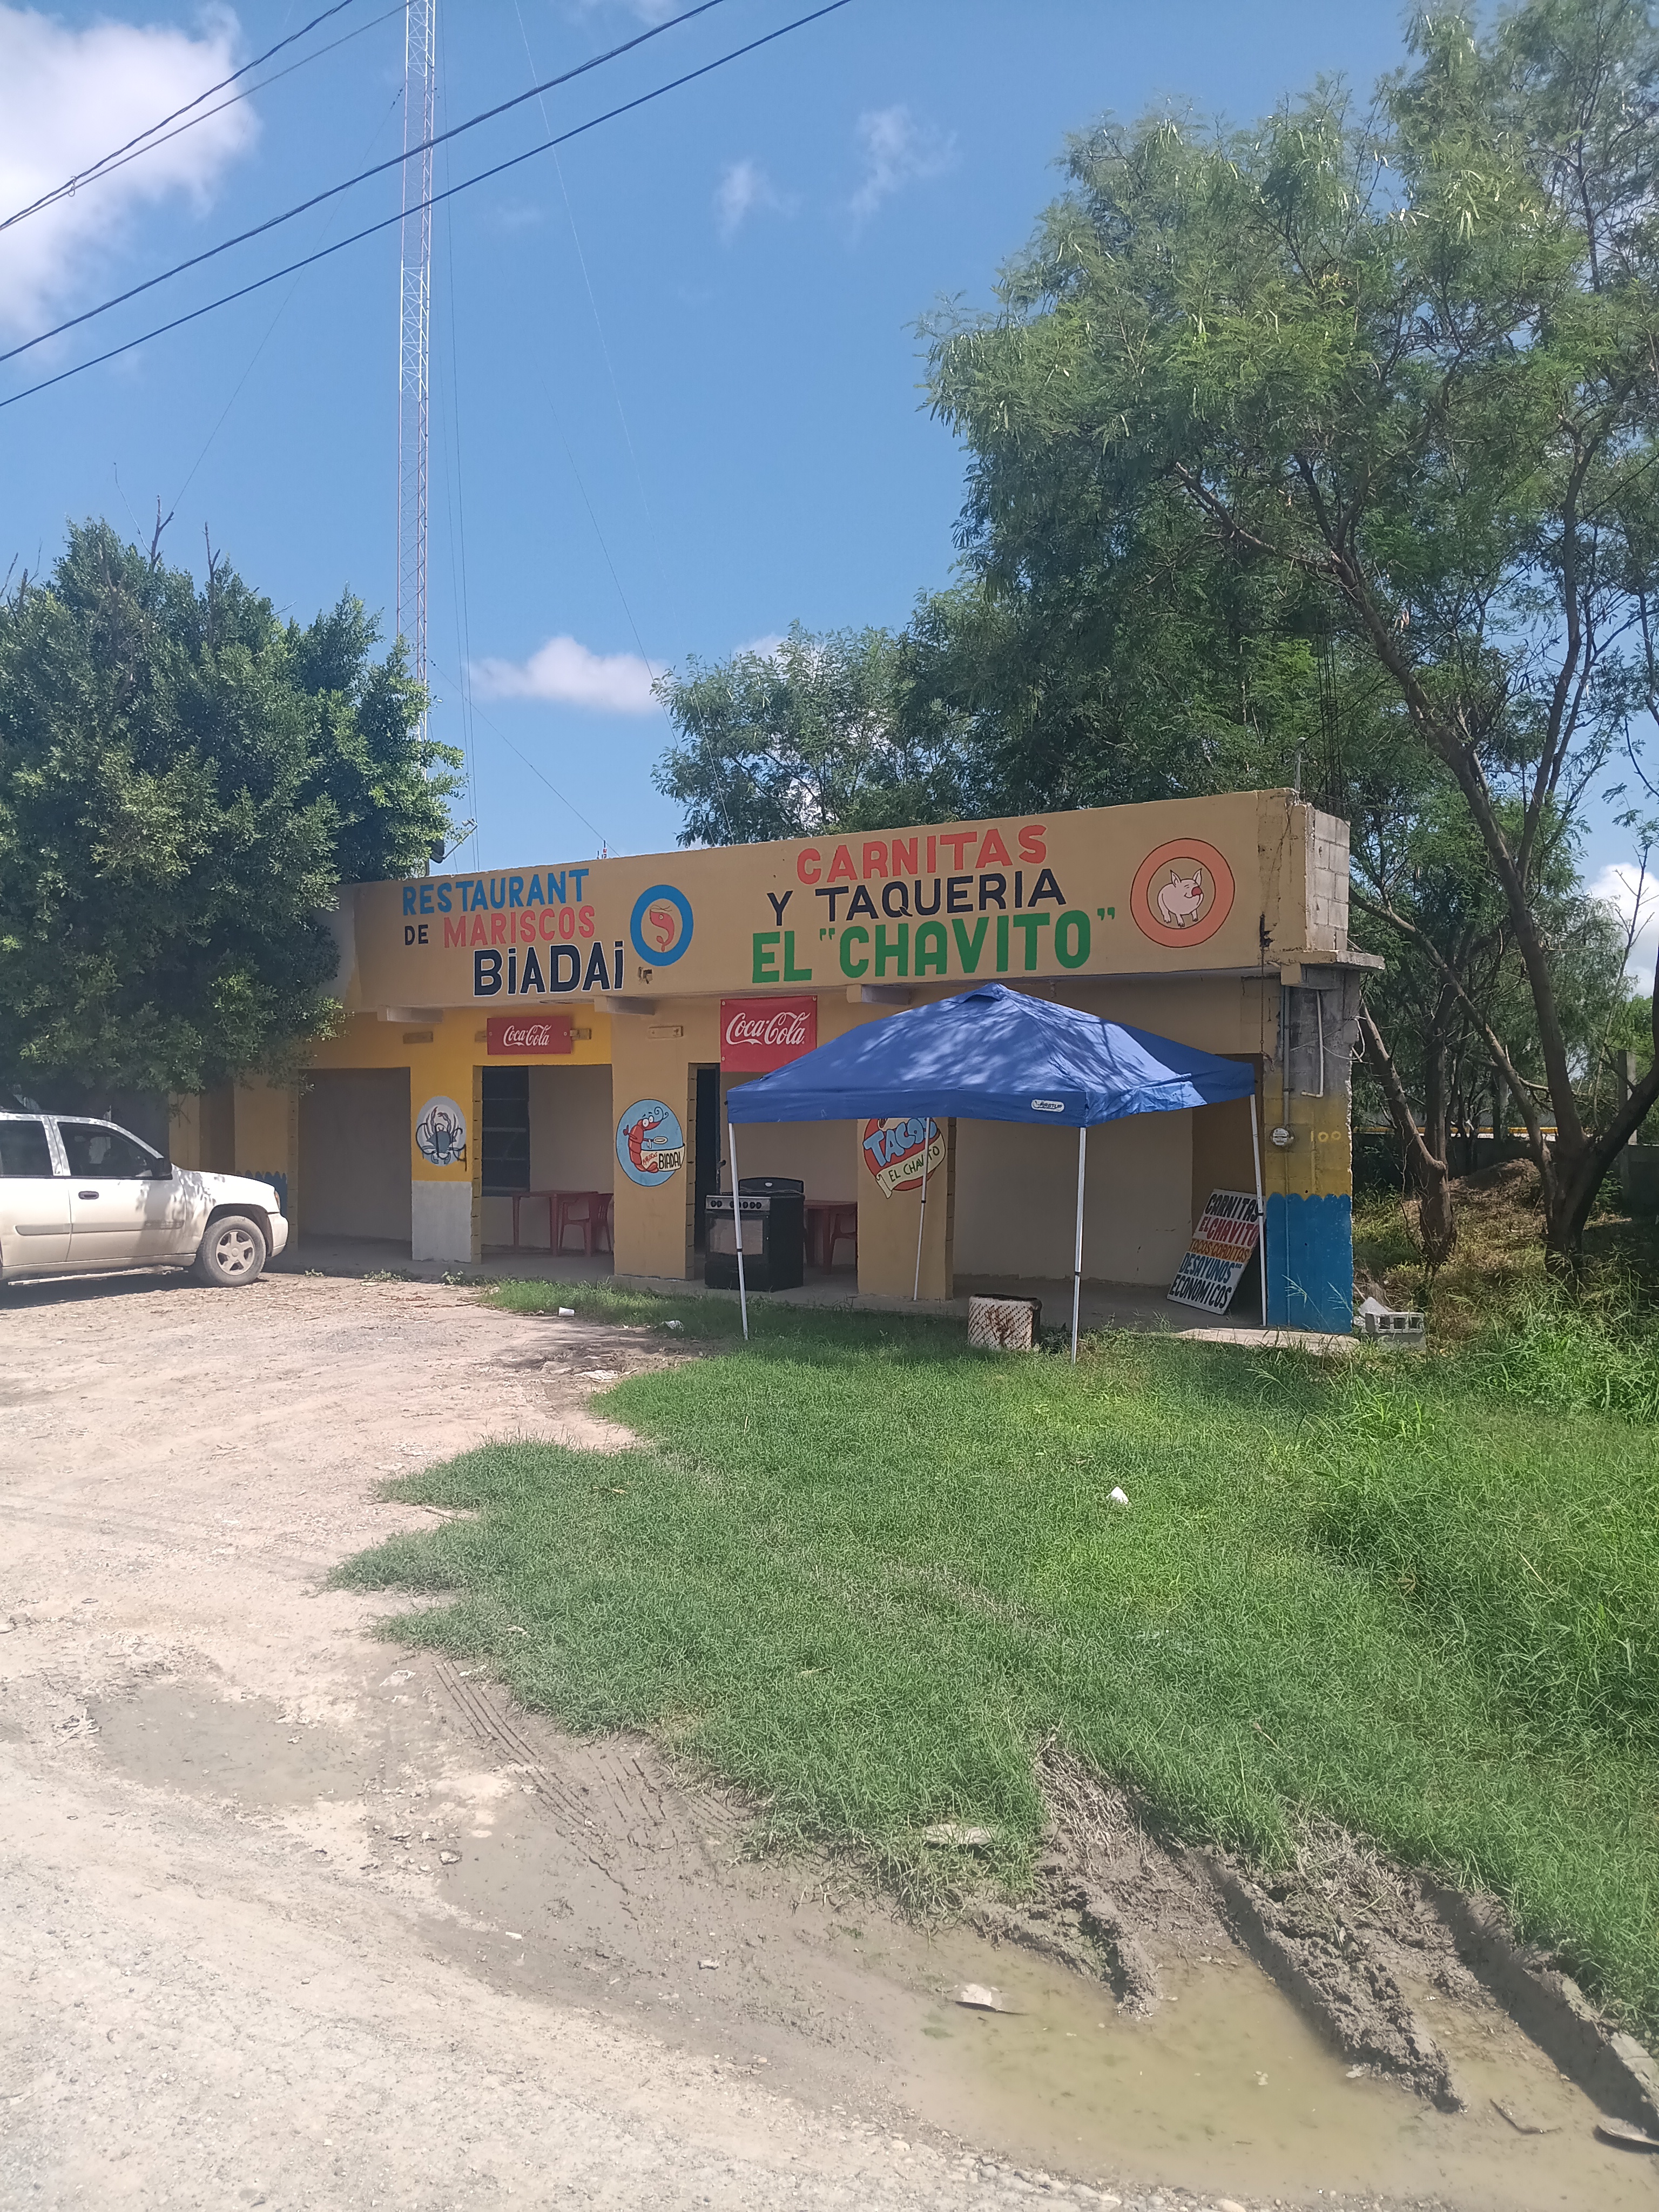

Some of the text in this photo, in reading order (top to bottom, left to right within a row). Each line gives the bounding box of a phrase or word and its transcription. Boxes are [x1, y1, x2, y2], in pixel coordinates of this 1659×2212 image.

[796, 825, 1047, 885] CARNITAS
[402, 868, 590, 915] RESTAURANT
[767, 868, 1066, 927] Y TAQUERIA
[404, 905, 595, 948] DE MARISCOS
[752, 930, 812, 983] EL
[503, 1024, 552, 1047] Coca-Cola
[726, 1011, 811, 1046] Coca-Cola
[1311, 1130, 1341, 1142] 100
[659, 1151, 681, 1169] BIADAI
[888, 1145, 940, 1183] EL CHAVTO
[1205, 1193, 1264, 1223] CARNITAS
[1198, 1216, 1260, 1247] EL CHAVITO
[1169, 1274, 1232, 1309] ECONOMICOS
